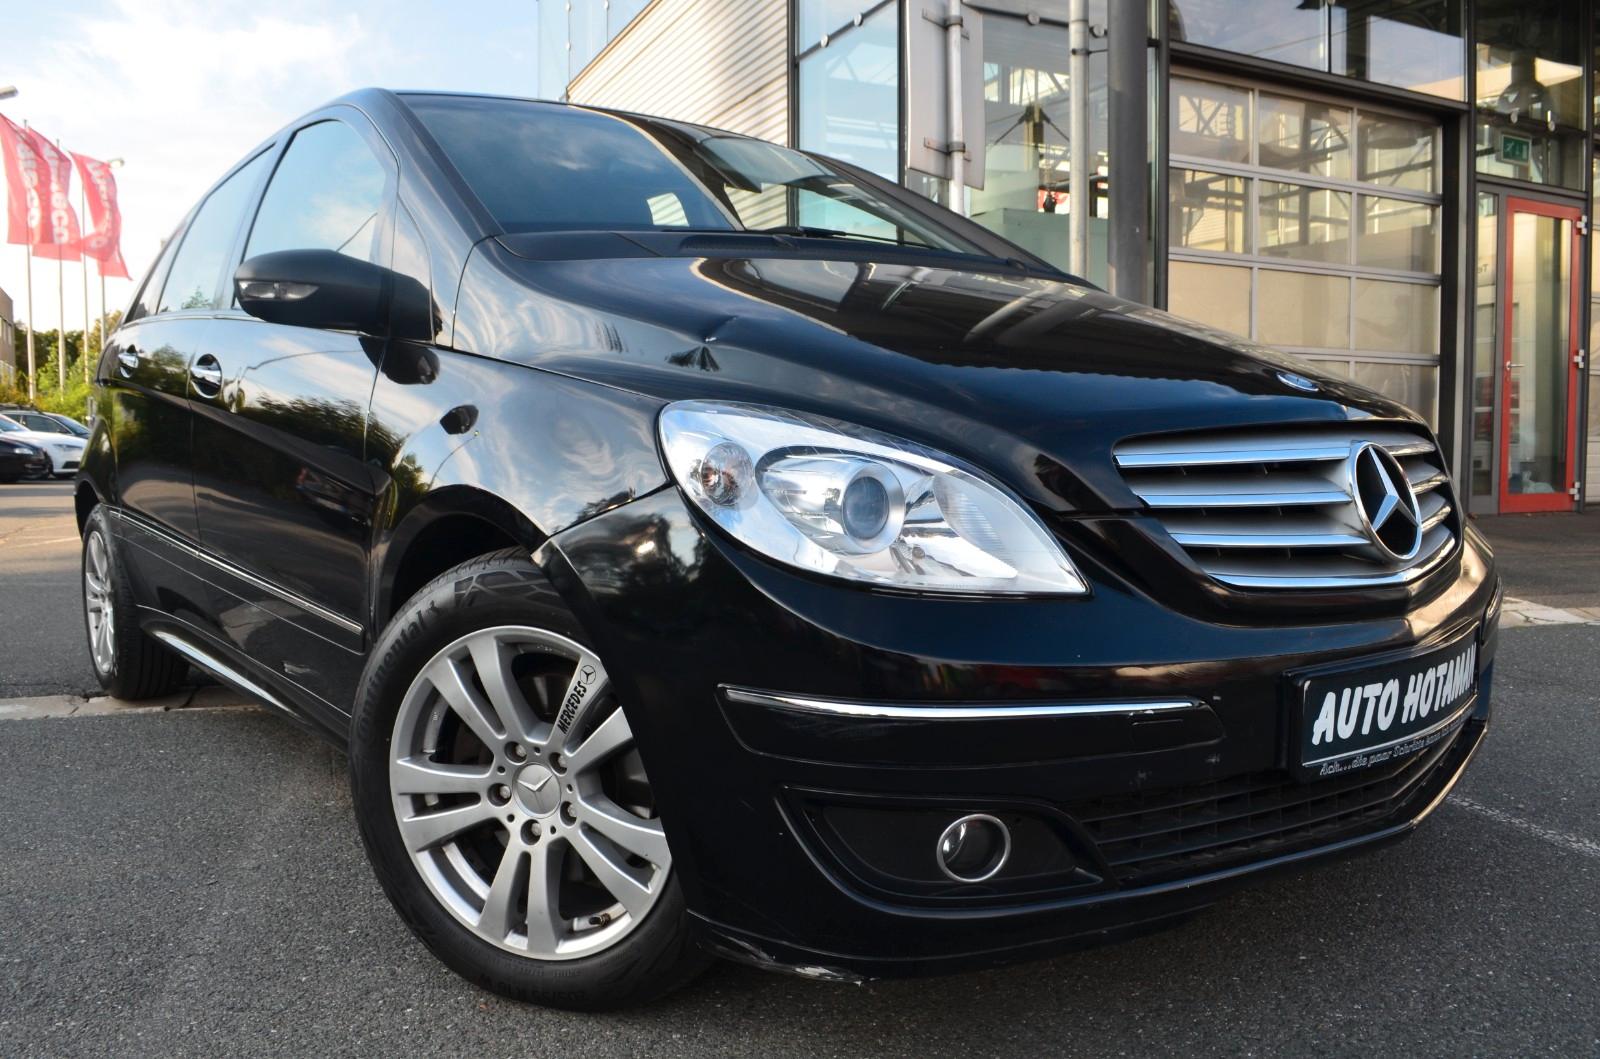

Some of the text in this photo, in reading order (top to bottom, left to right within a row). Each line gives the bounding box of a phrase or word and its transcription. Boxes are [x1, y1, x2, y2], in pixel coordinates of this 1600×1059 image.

[556, 680, 587, 735] MERCEDES
[1312, 678, 1400, 746] AUTO
[1401, 641, 1477, 724] HOTAMAN
